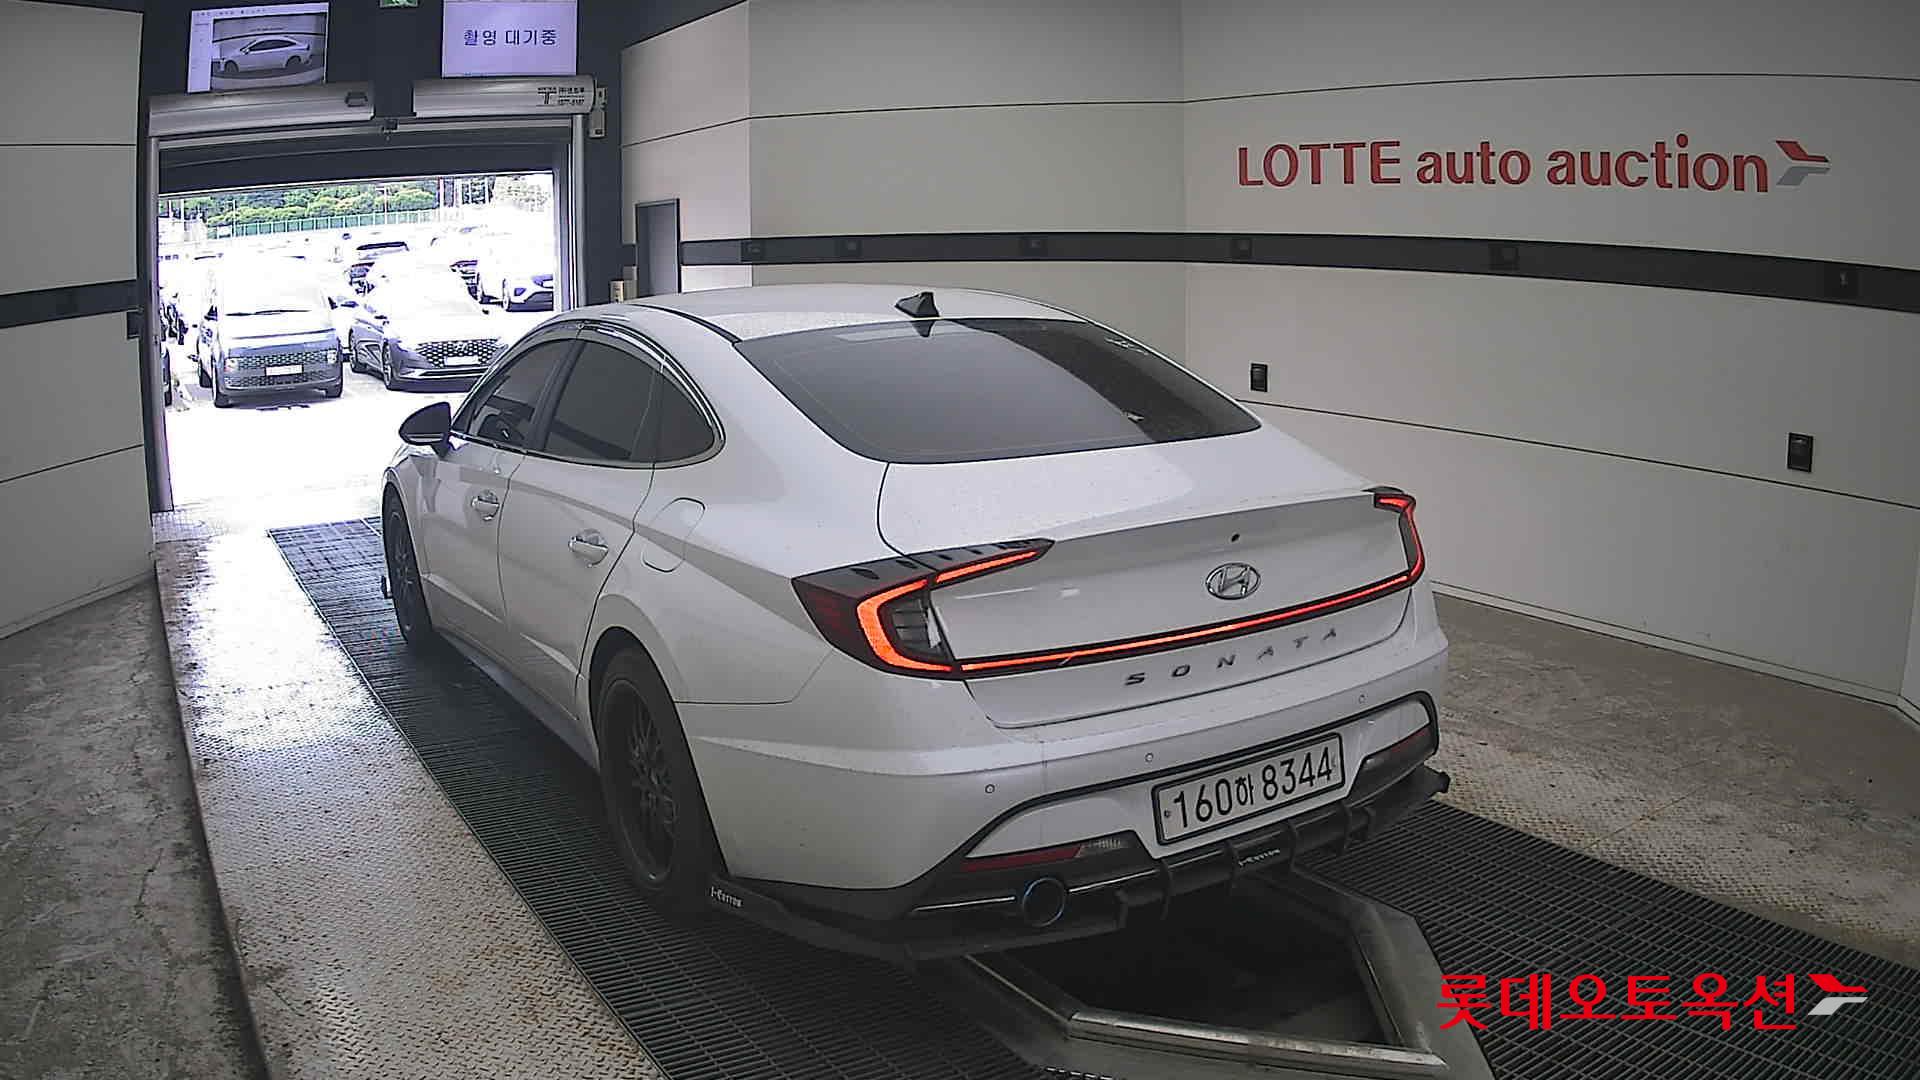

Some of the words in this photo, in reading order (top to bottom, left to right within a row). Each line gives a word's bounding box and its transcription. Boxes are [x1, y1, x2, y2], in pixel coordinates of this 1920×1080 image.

[505, 29, 557, 46] 대기중
[1238, 140, 1401, 188] LOTTE
[1416, 140, 1532, 185] auto
[1546, 133, 1769, 193] auction
[1124, 627, 1337, 687] SONATA
[1173, 772, 1255, 828] 160하
[1261, 746, 1333, 801] 8344
